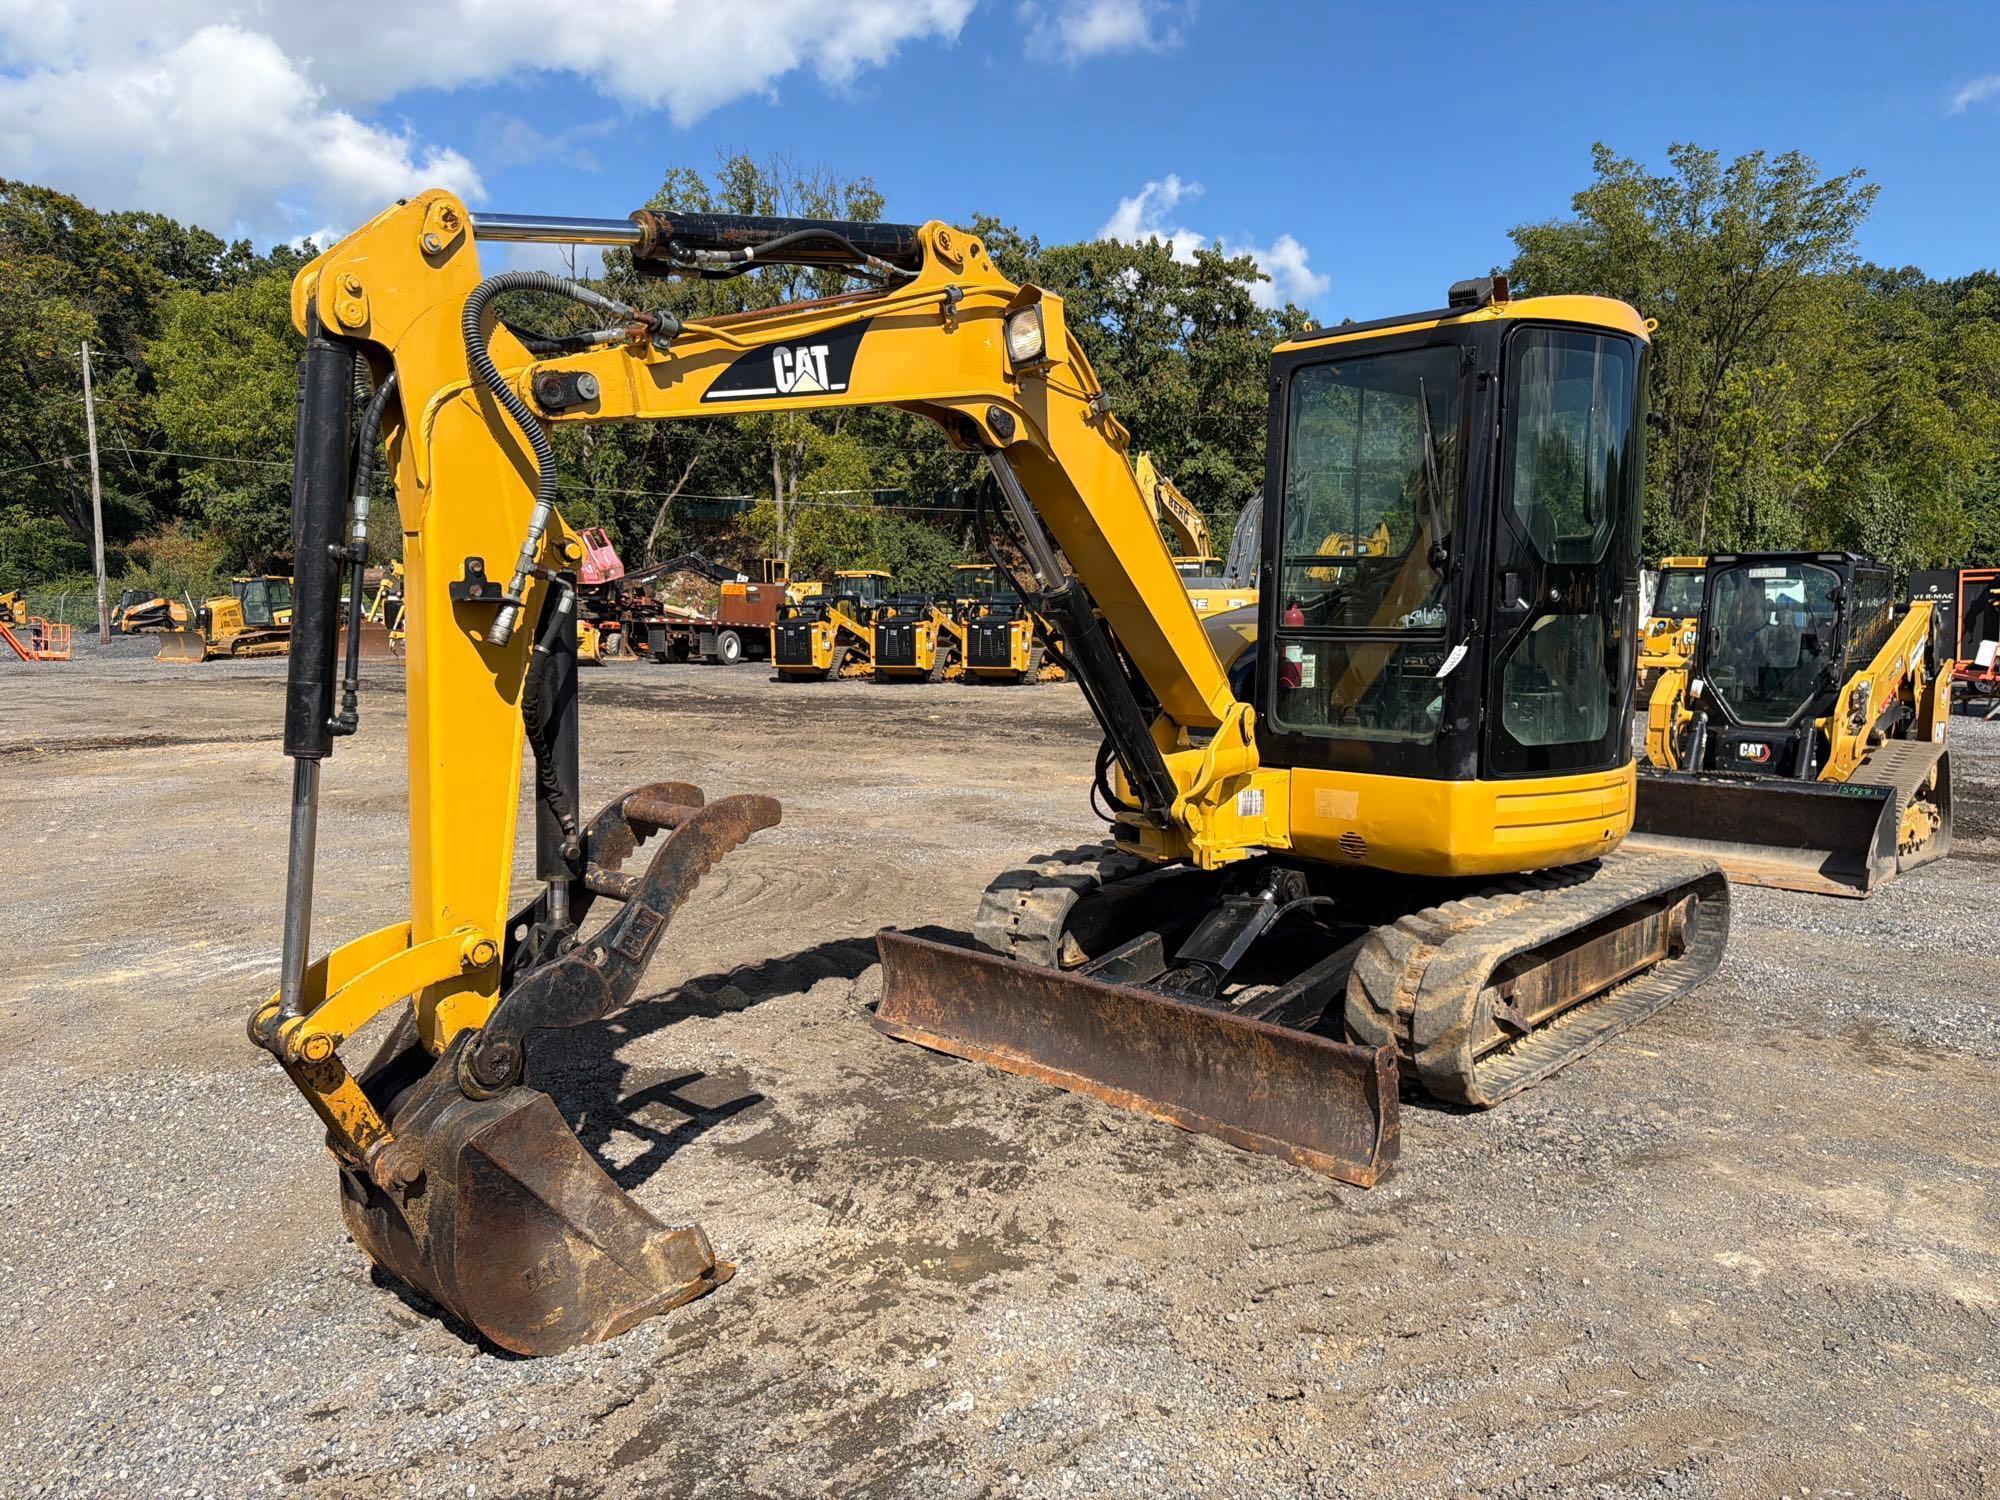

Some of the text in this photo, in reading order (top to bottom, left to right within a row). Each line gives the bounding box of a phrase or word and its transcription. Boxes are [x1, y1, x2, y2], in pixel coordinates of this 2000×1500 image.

[772, 345, 829, 394] CAT
[1168, 495, 1189, 526] BERG
[1683, 631, 1696, 645] CA
[1739, 742, 1764, 758] CAT
